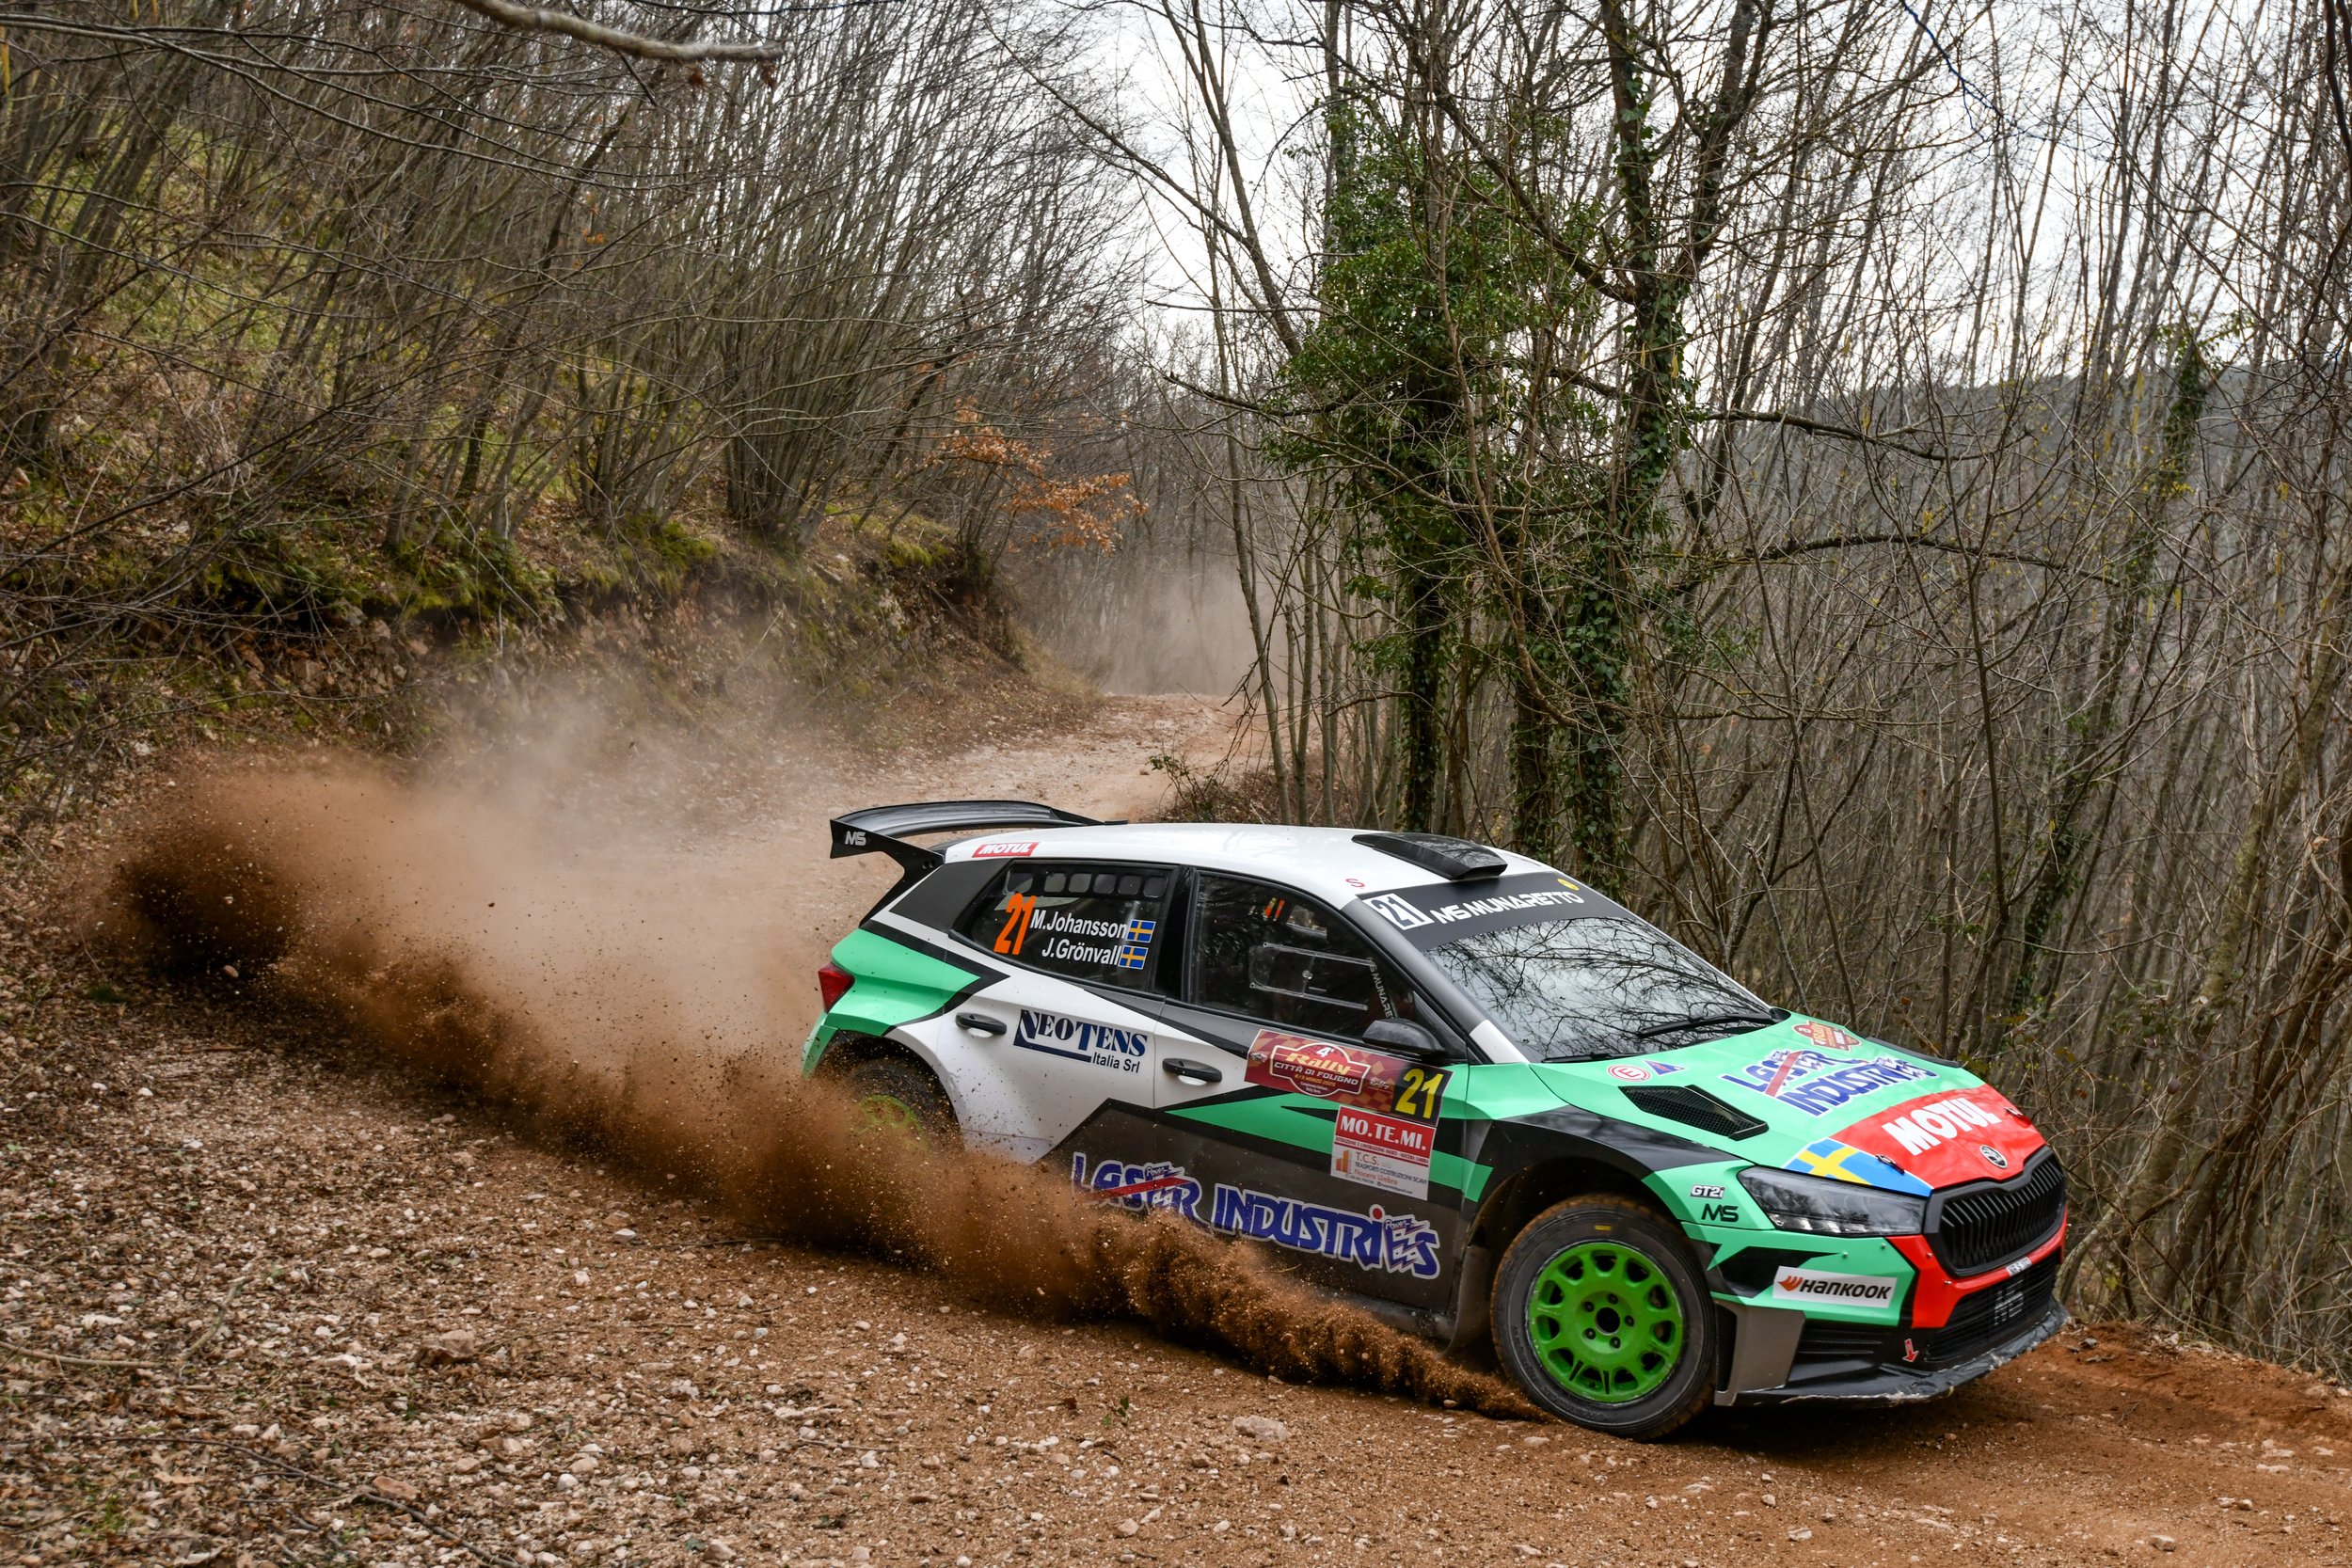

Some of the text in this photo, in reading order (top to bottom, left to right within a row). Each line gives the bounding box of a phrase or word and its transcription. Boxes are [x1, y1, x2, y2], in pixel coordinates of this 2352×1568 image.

[845, 831, 866, 846] MS
[978, 843, 1031, 854] MOTUL
[1370, 895, 1423, 927] 21
[1429, 891, 1585, 924] MS MUNARETTO
[993, 893, 1037, 955] 21
[1030, 909, 1128, 939] M.Johansson
[1041, 938, 1123, 966] J.Grönvall
[1013, 1009, 1148, 1057] NEOTENS
[1092, 1052, 1140, 1073] Italia Srl
[1274, 1061, 1304, 1074] CITTÀ
[1317, 1070, 1359, 1085] FOLIGNO
[1285, 1053, 1352, 1075] Rally
[1394, 1068, 1444, 1119] 21
[1339, 1115, 1427, 1151] MO.TE.MI.
[1882, 1098, 2003, 1155] MOTUL
[1356, 1151, 1379, 1165] T.C.S.
[1691, 1184, 1724, 1198] GT2i
[1701, 1203, 1739, 1222] MS
[1213, 1184, 1438, 1278] INDUSTRIES
